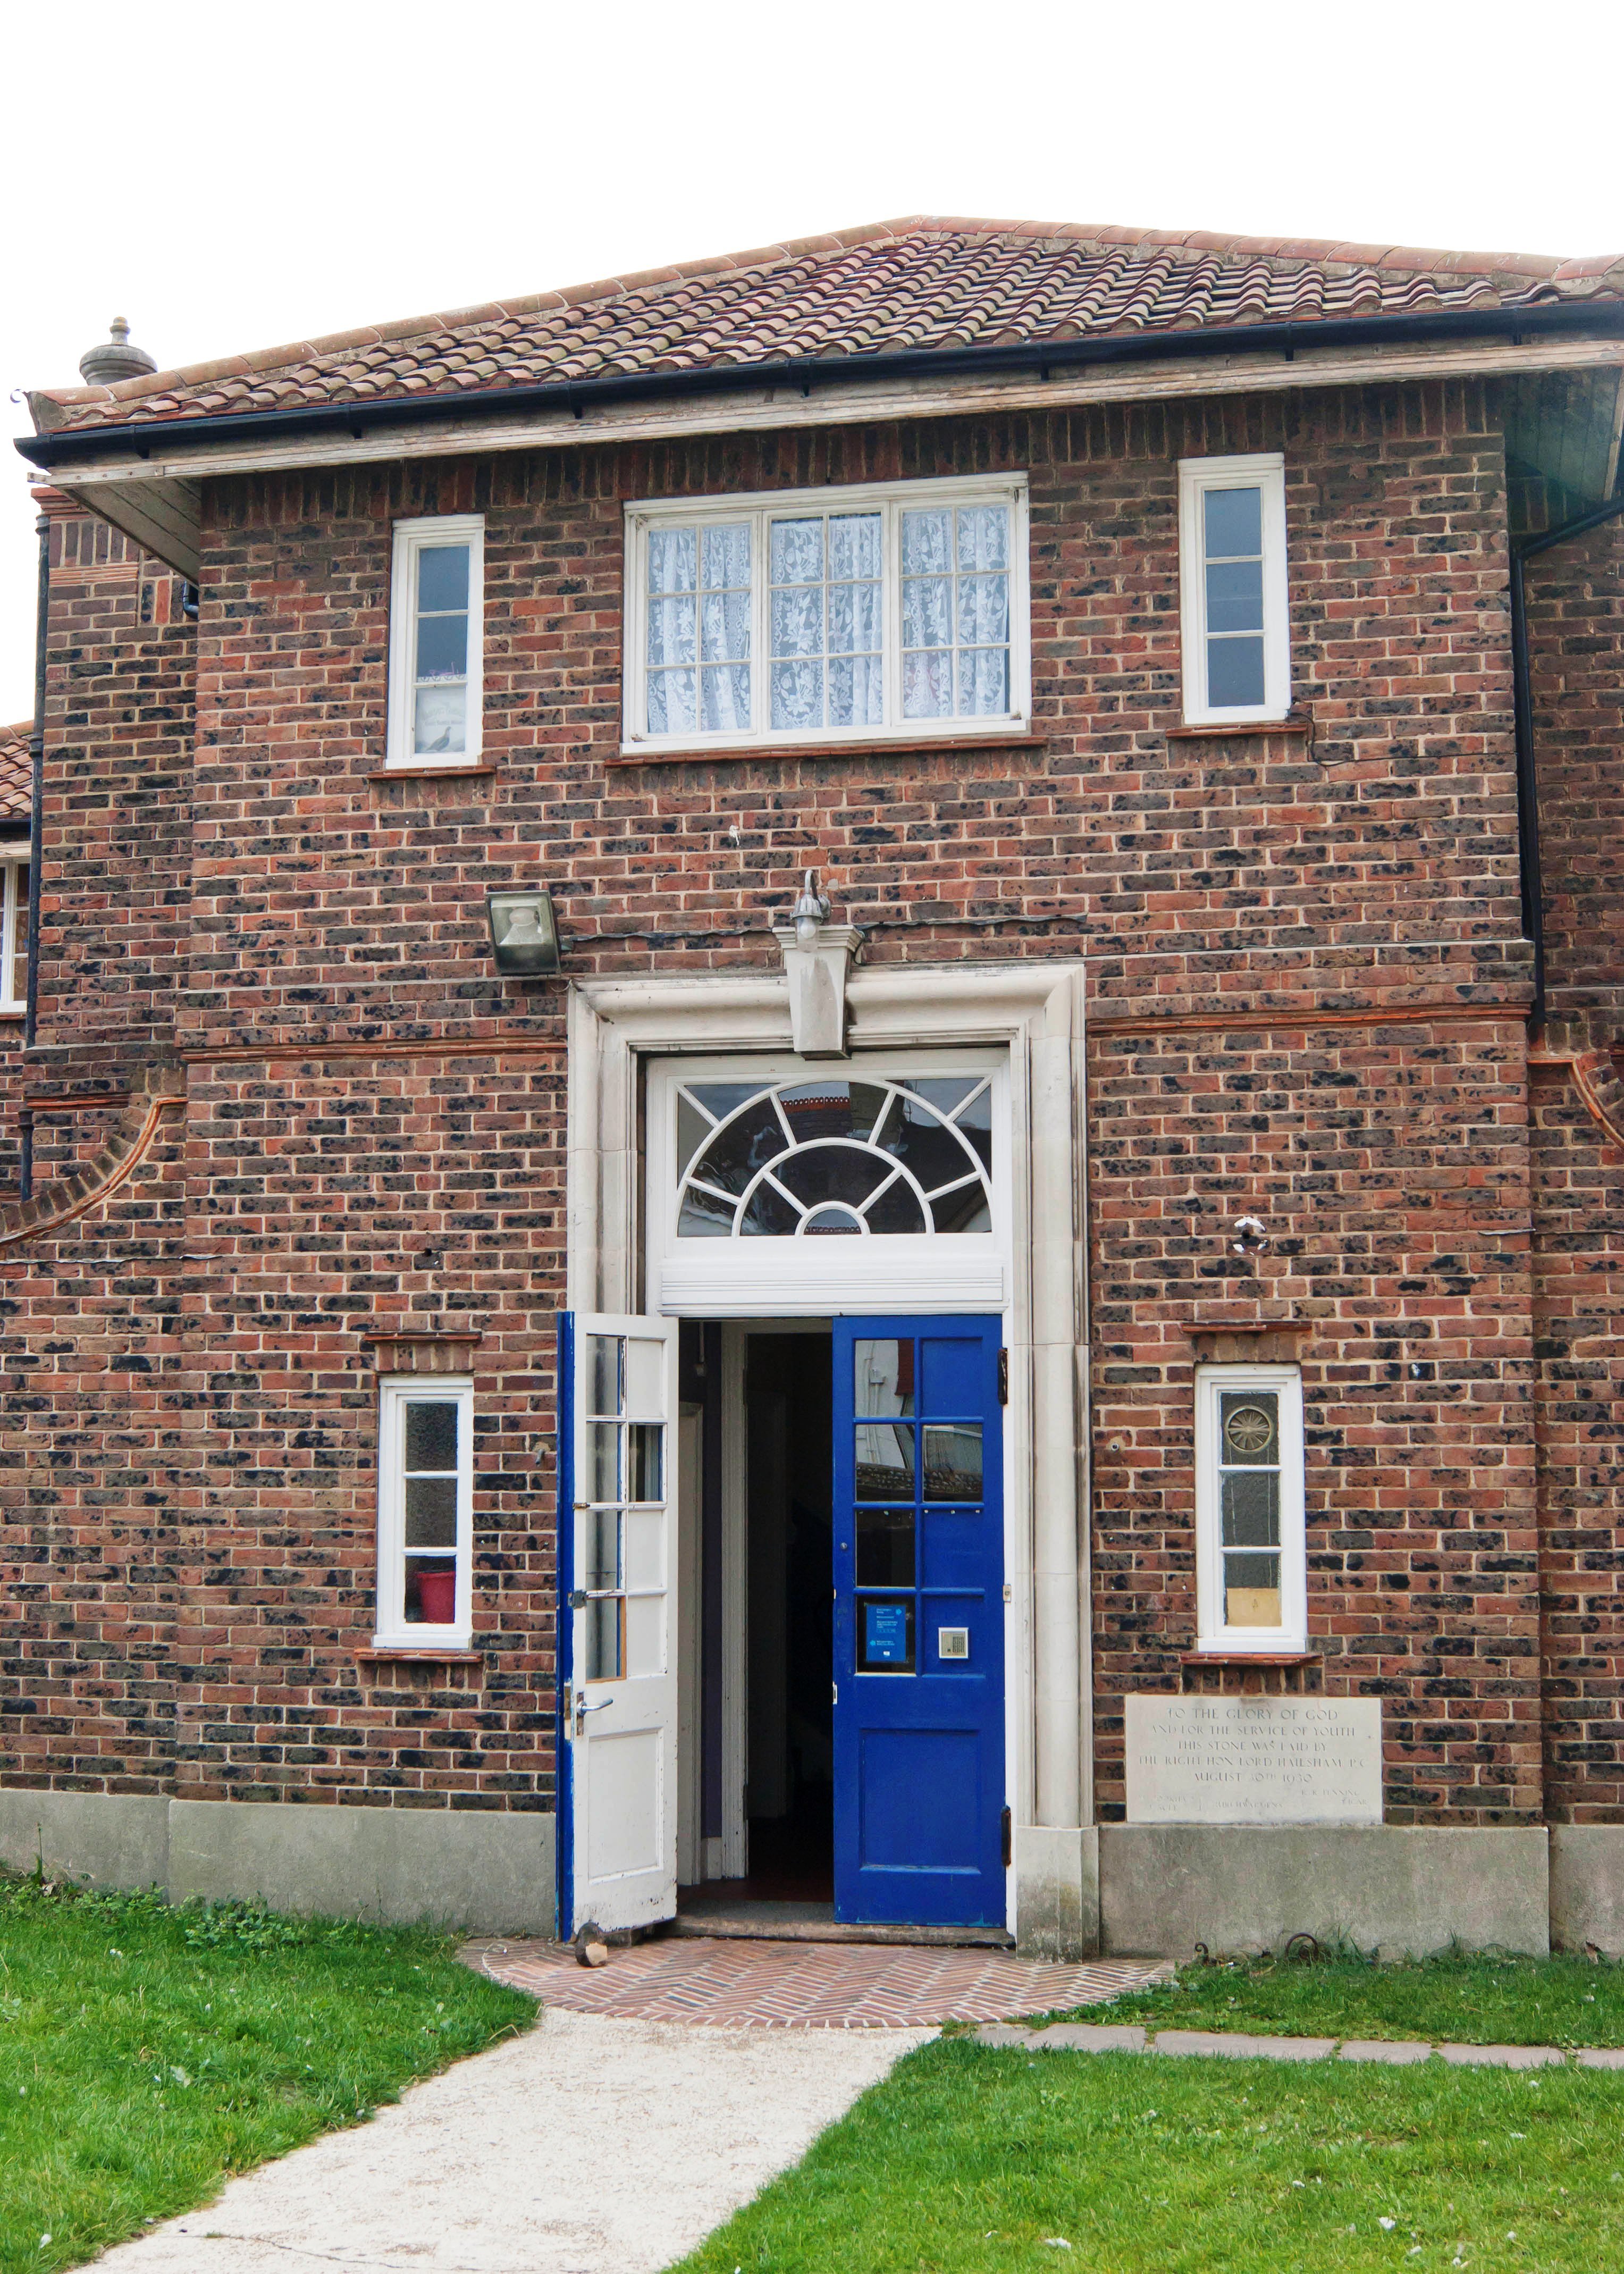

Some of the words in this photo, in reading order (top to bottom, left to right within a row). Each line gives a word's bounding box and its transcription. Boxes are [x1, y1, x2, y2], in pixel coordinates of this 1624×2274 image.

[1168, 1708, 1186, 1718] TO
[1192, 1708, 1219, 1719] THE
[1226, 1708, 1273, 1720] GLORY
[1280, 1709, 1298, 1720] OF
[1306, 1709, 1338, 1721] GOD
[1151, 1724, 1177, 1734] AND
[1181, 1725, 1204, 1735] FOR
[1210, 1725, 1230, 1735] THE
[1238, 1726, 1288, 1736] SERVICE
[1292, 1727, 1307, 1736] OF
[1314, 1727, 1355, 1736] YOUTH
[1178, 1740, 1202, 1750] THIS
[1208, 1741, 1246, 1751] STONE
[1252, 1741, 1275, 1751] WAS
[1280, 1742, 1308, 1751] LAID
[1314, 1742, 1327, 1752] BY
[1139, 1756, 1157, 1765] THE
[1165, 1756, 1201, 1766] RIGHT
[1207, 1756, 1234, 1766] HON
[1239, 1757, 1272, 1767] LORD
[1278, 1757, 1342, 1768] HAILSHAM
[1194, 1773, 1242, 1782] AUGUST
